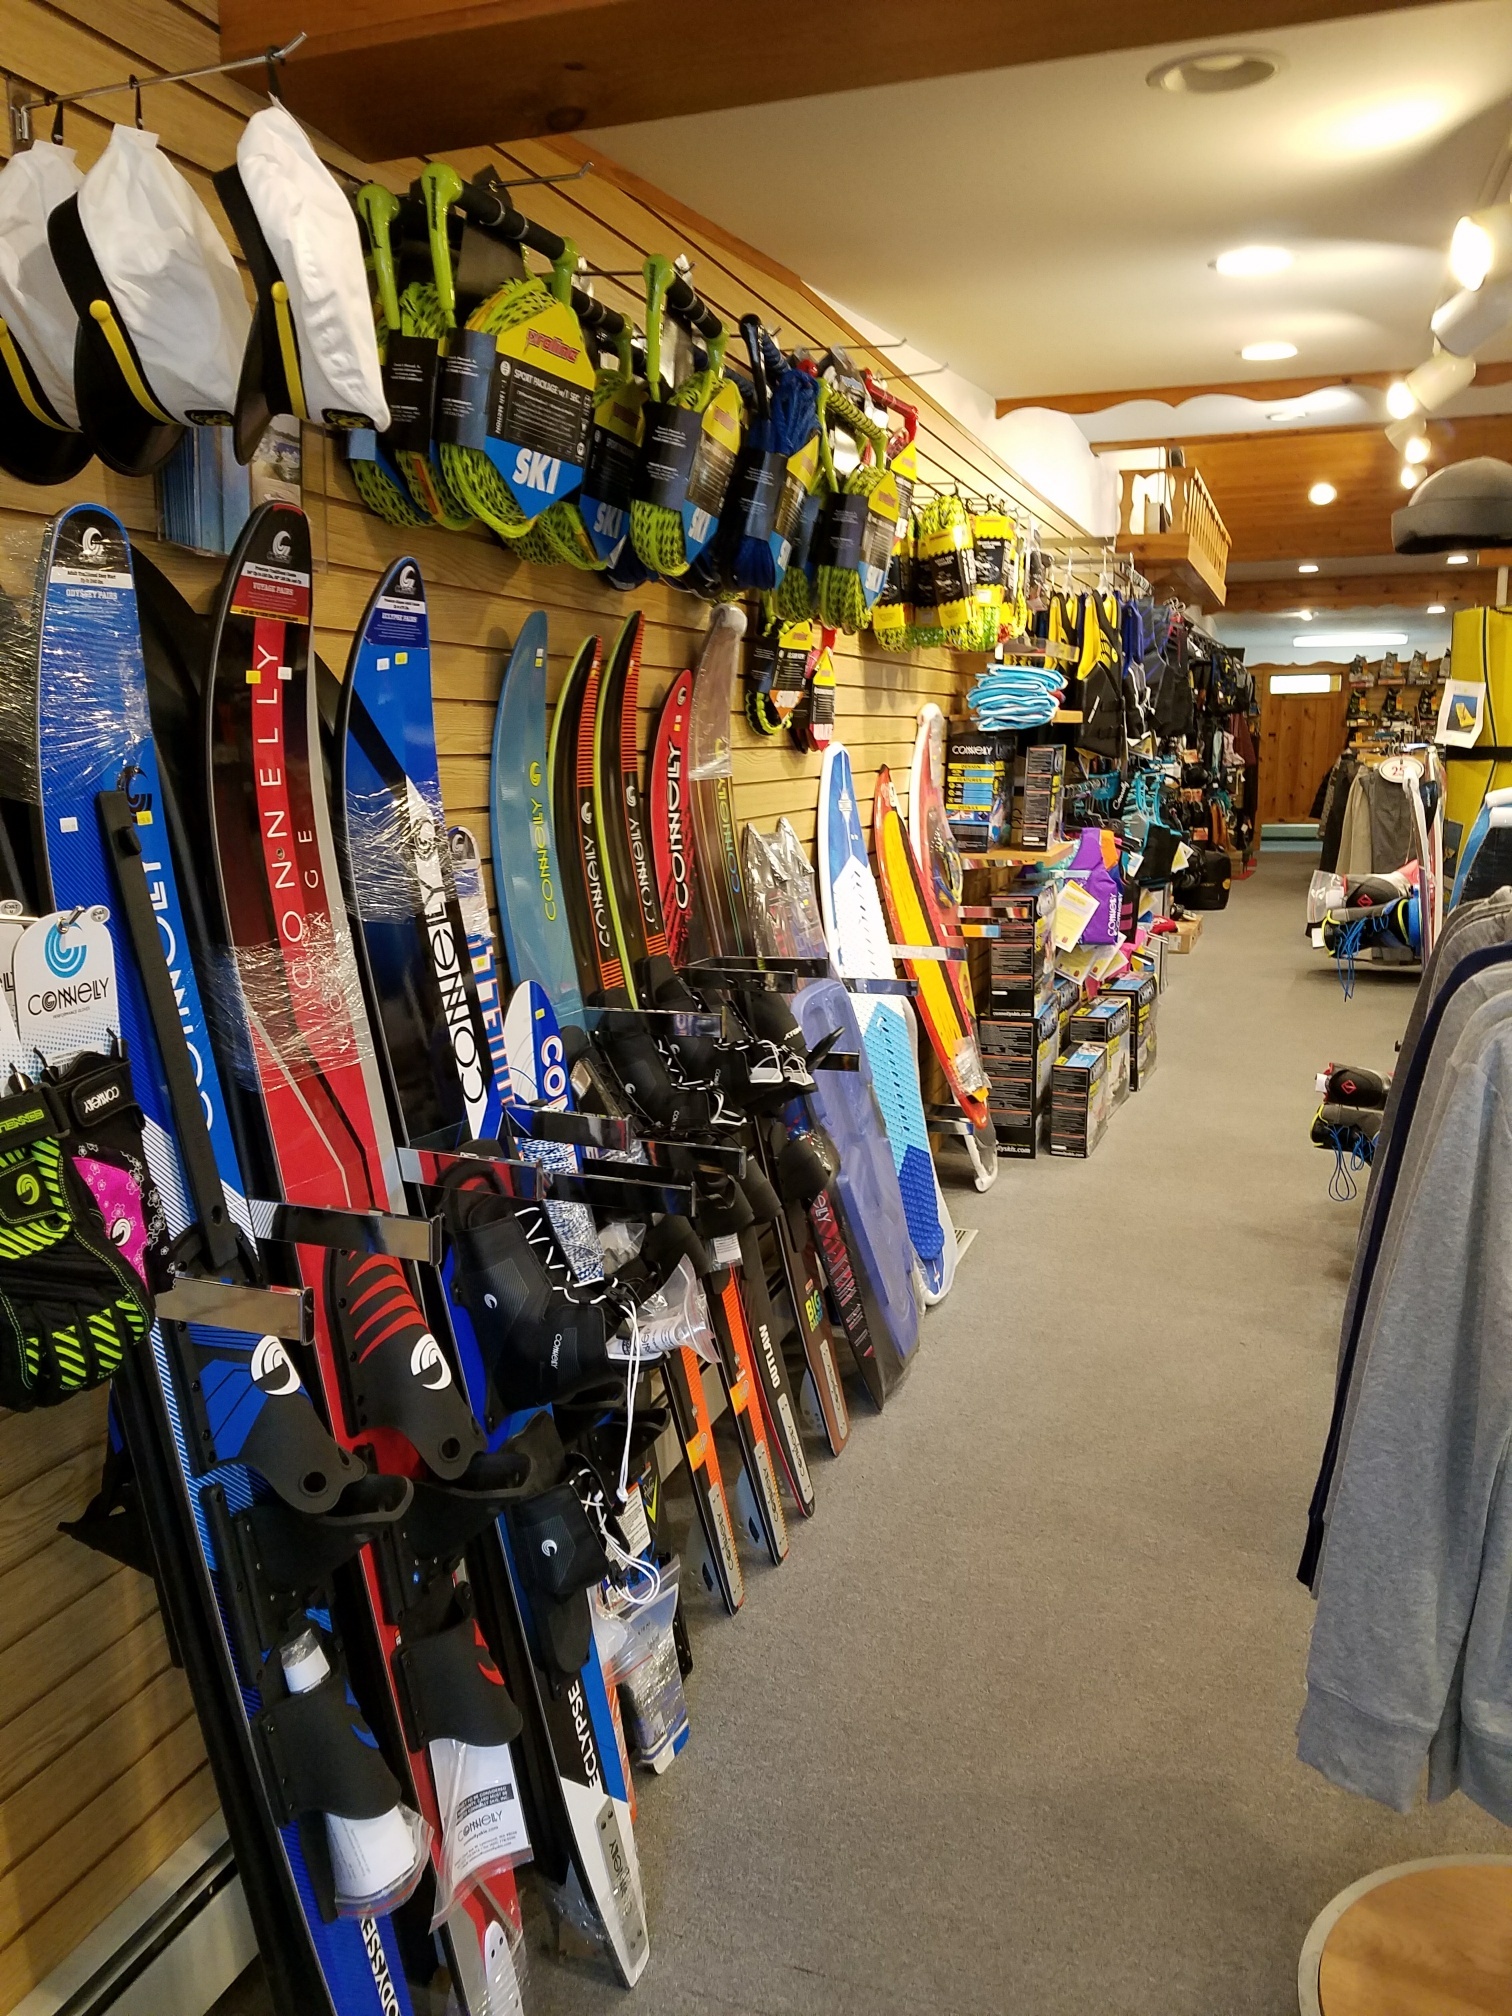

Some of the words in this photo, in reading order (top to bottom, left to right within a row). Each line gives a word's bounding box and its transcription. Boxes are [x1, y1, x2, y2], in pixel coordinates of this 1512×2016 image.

[512, 447, 561, 495] SKI
[804, 1289, 823, 1322] BIG
[758, 1323, 782, 1390] OUTLAW
[567, 1680, 601, 1789] ECLYPSE
